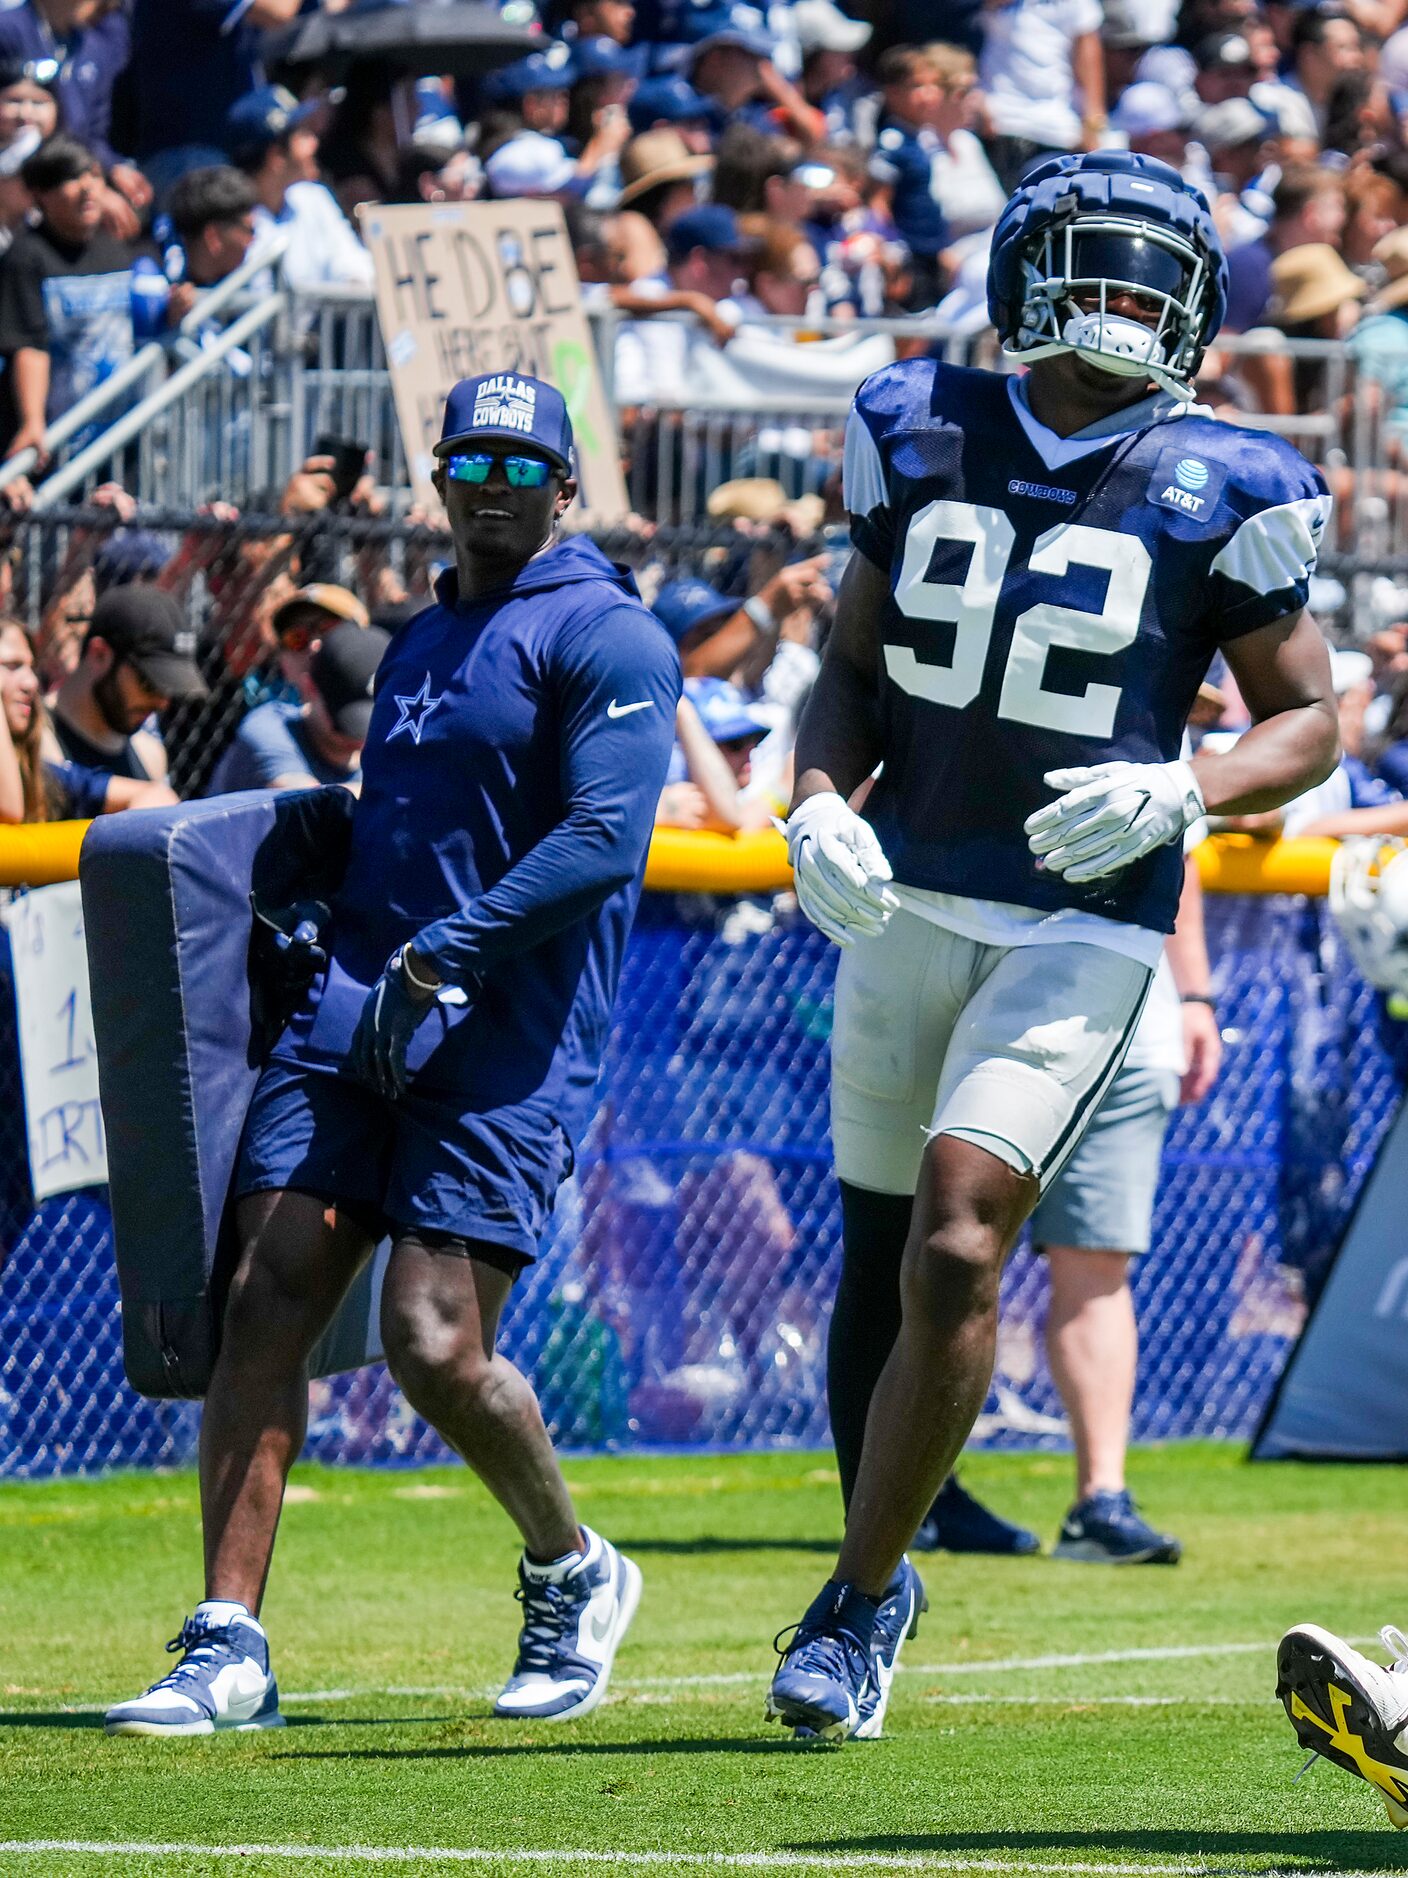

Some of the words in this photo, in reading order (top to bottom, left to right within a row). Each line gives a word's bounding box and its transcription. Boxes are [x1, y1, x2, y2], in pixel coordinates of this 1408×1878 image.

[476, 376, 535, 404] DALLAS
[473, 406, 534, 433] COWBOYS
[1008, 479, 1077, 504] COWBOYS
[1161, 485, 1205, 512] AT&T
[883, 499, 1152, 739] 92
